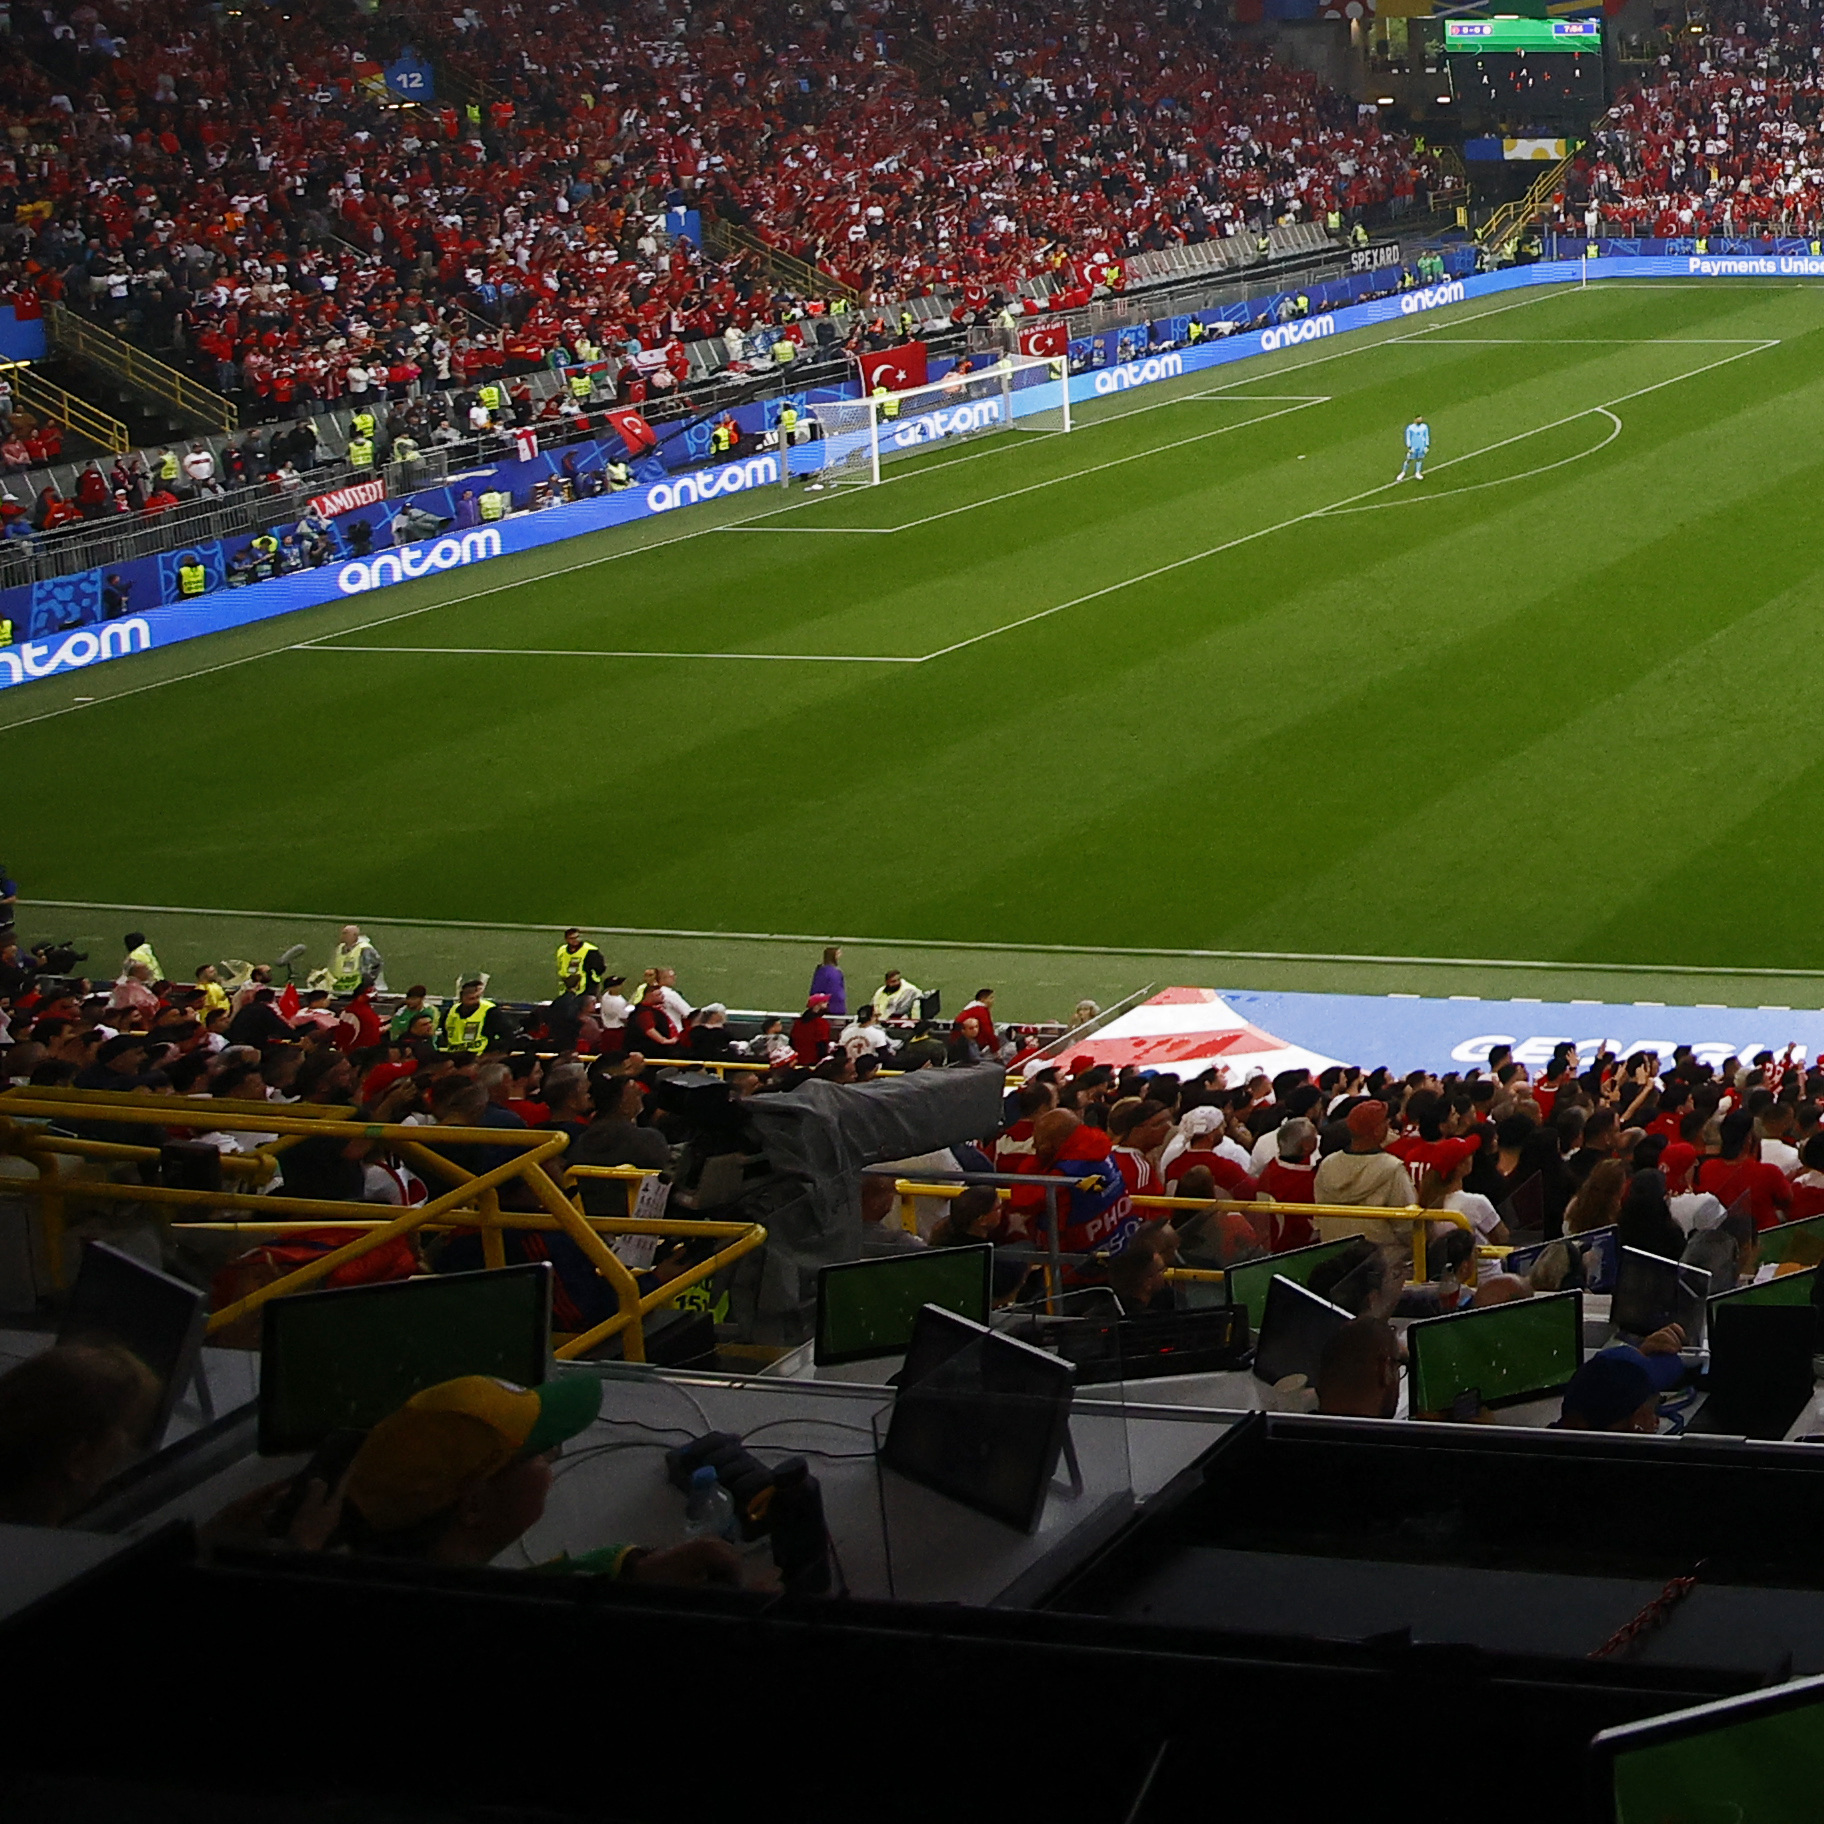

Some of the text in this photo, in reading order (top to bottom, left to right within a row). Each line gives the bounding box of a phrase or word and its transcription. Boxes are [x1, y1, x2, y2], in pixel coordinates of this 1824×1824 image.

[396, 72, 424, 88] 12
[1351, 245, 1399, 271] SPEXARD
[1689, 257, 1776, 276] Payments
[1401, 280, 1464, 314] antom
[1261, 314, 1334, 351] antom
[1094, 353, 1183, 394] antom
[894, 400, 999, 447] antom
[647, 457, 777, 514] antom
[339, 528, 502, 594] antom
